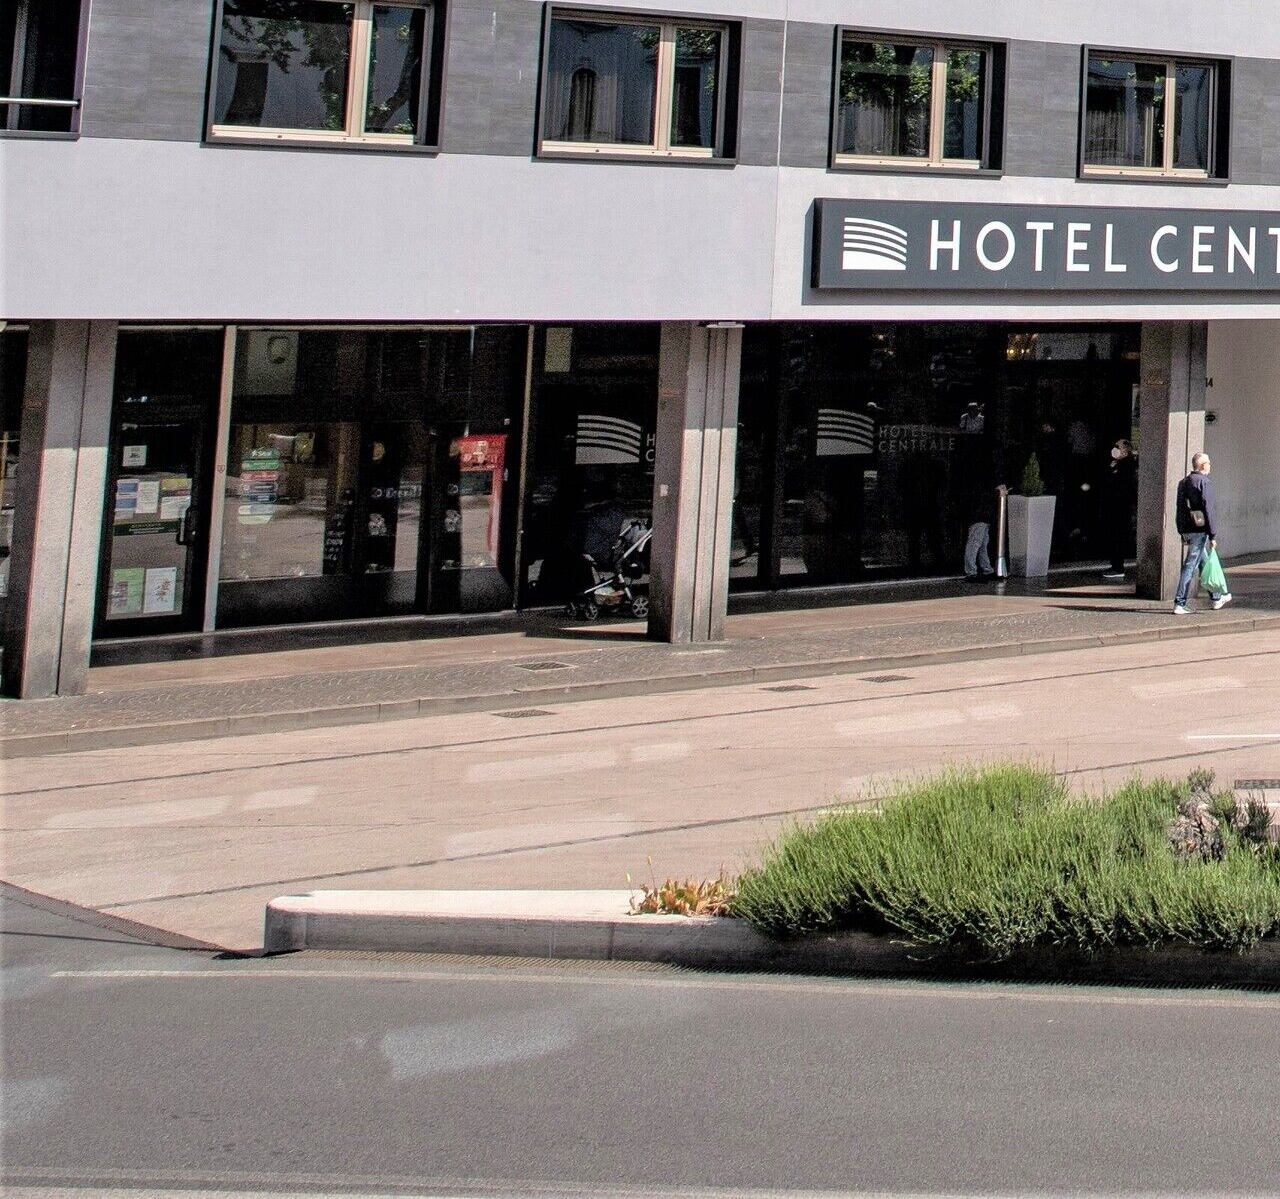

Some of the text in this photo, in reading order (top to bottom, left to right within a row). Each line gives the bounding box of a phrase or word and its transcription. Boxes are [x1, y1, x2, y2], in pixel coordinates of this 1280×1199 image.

[928, 219, 1127, 272] HOTEL
[878, 425, 928, 438] HOTEL
[878, 437, 956, 452] CENTRALE
